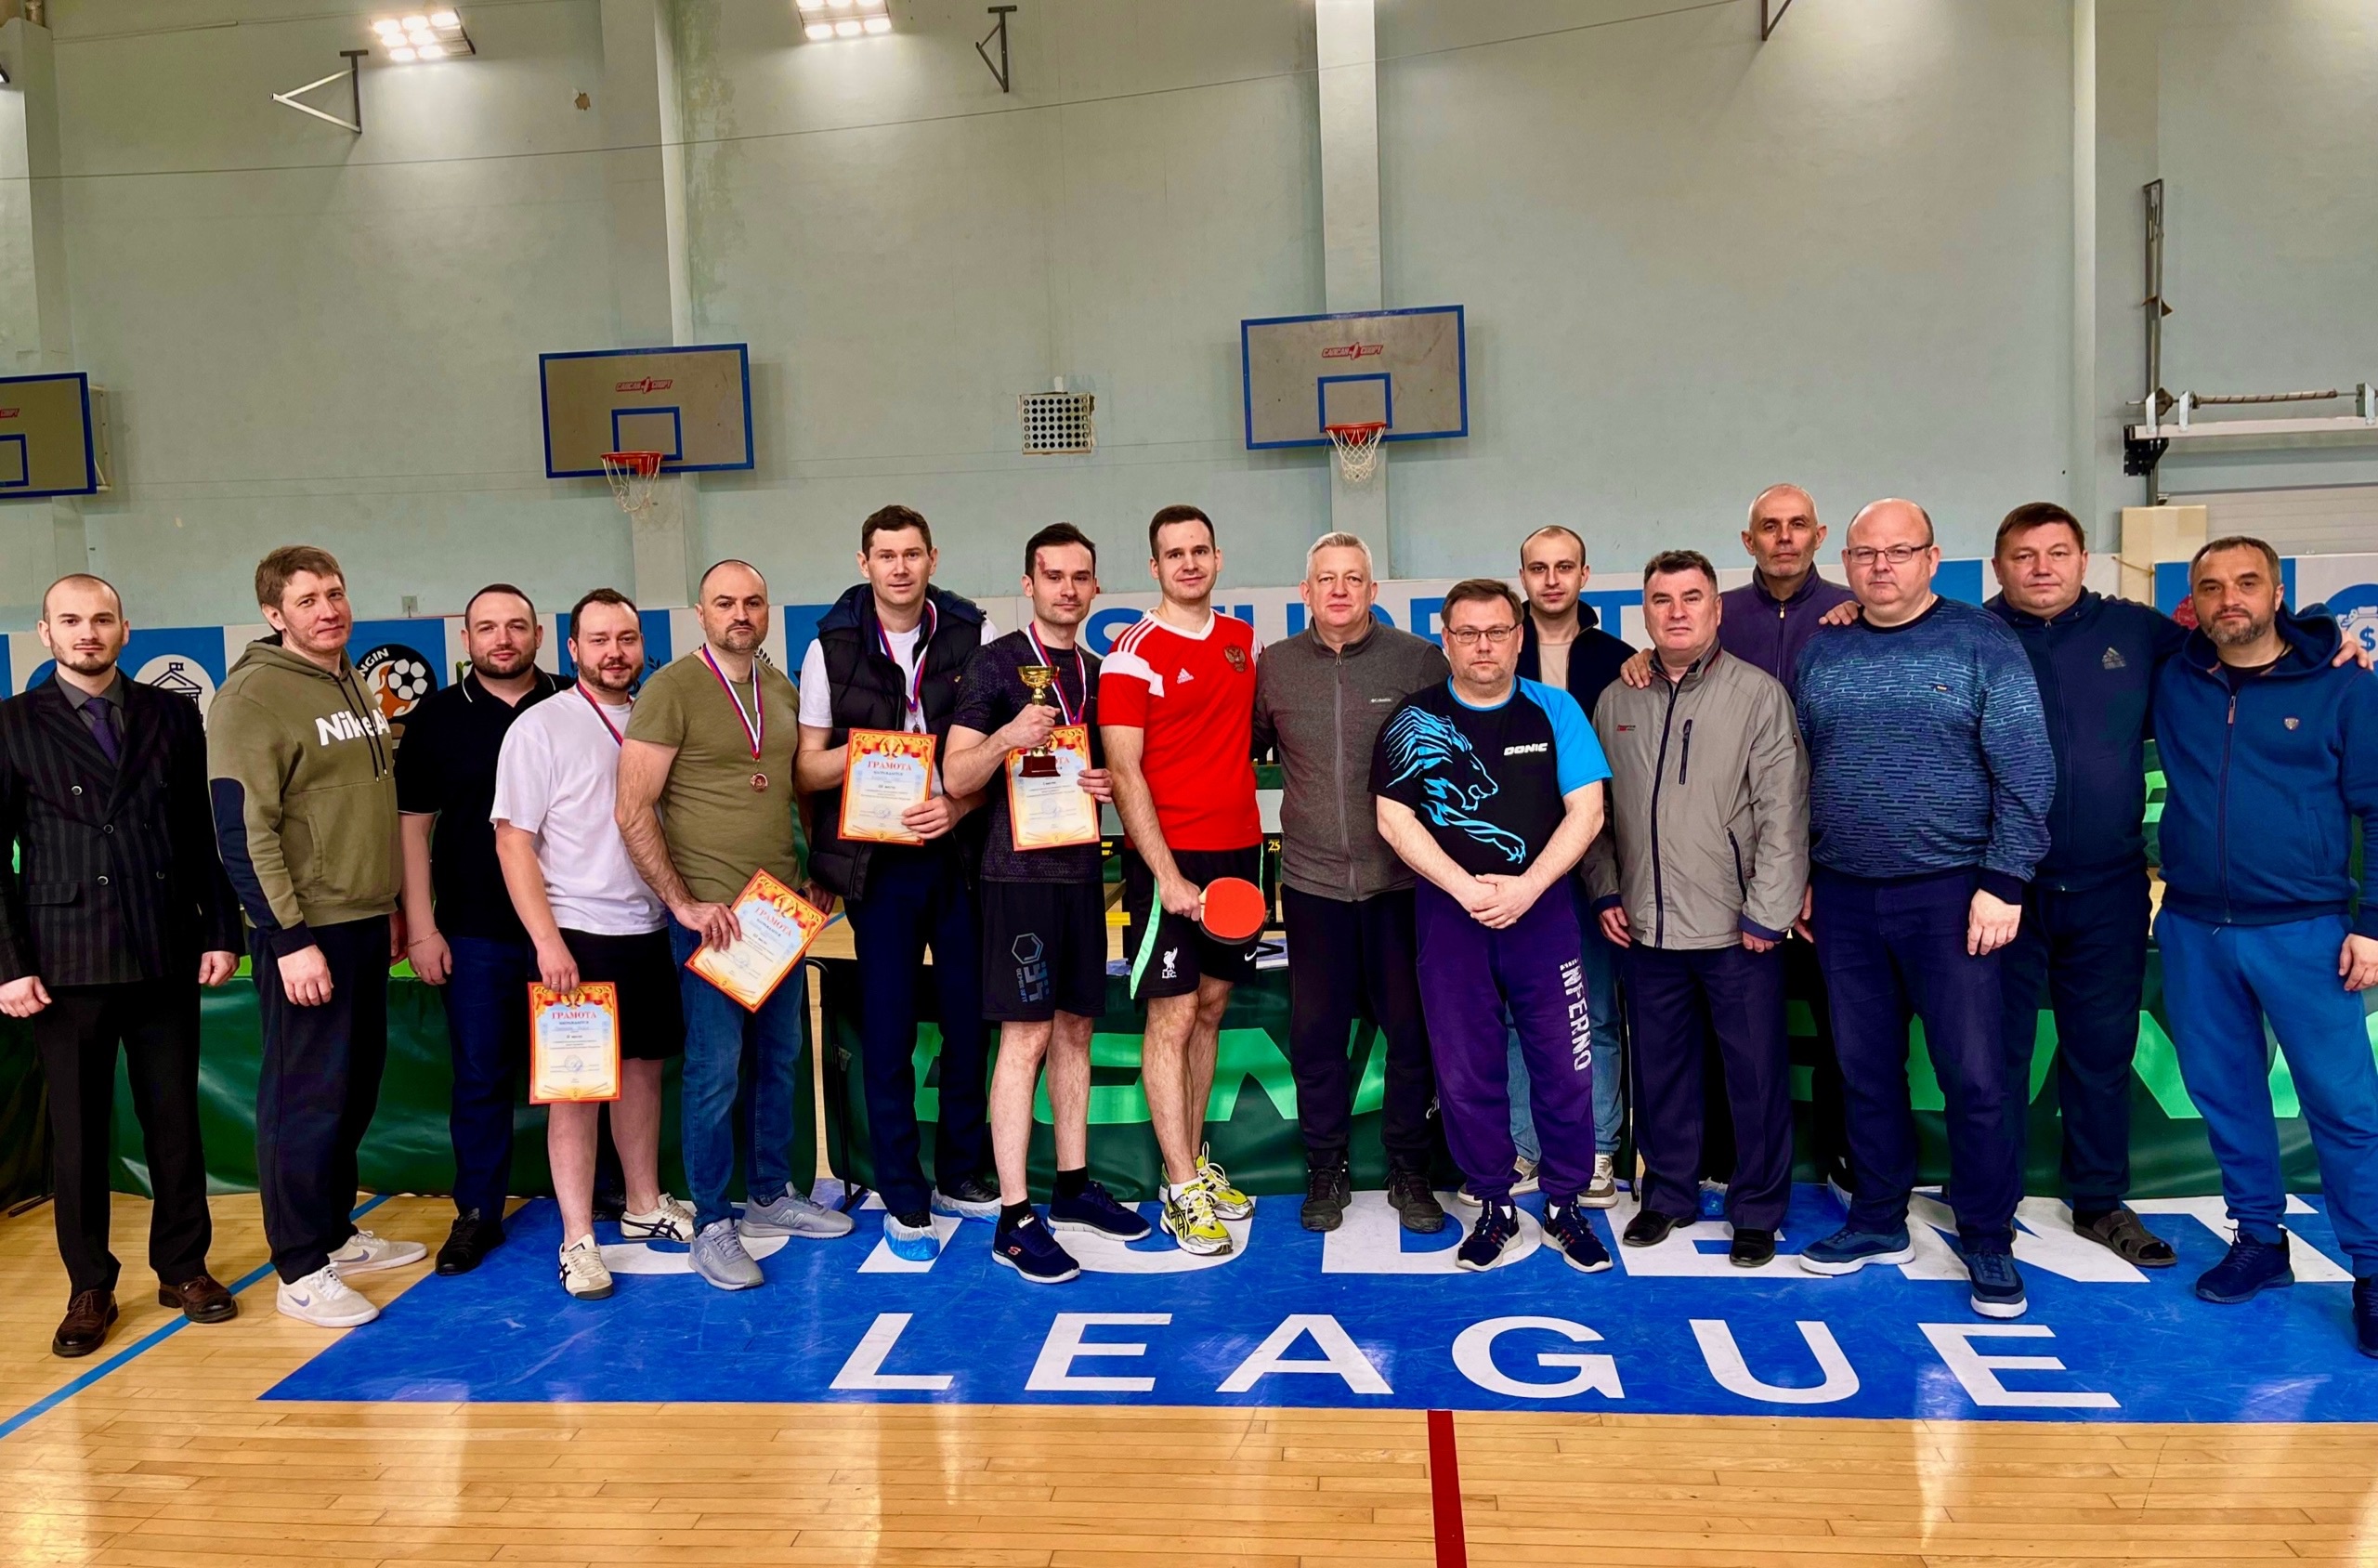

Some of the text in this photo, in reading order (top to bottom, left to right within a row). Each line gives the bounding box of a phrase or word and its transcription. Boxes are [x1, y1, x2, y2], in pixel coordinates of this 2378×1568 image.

[1504, 742, 1548, 756] DONIC
[868, 760, 912, 771] ГРАМОТА
[1268, 841, 1281, 851] 25
[754, 907, 793, 937] ГРАМОТА
[552, 1011, 597, 1020] ГРАМОТА
[829, 1313, 2123, 1408] LEAGUE
